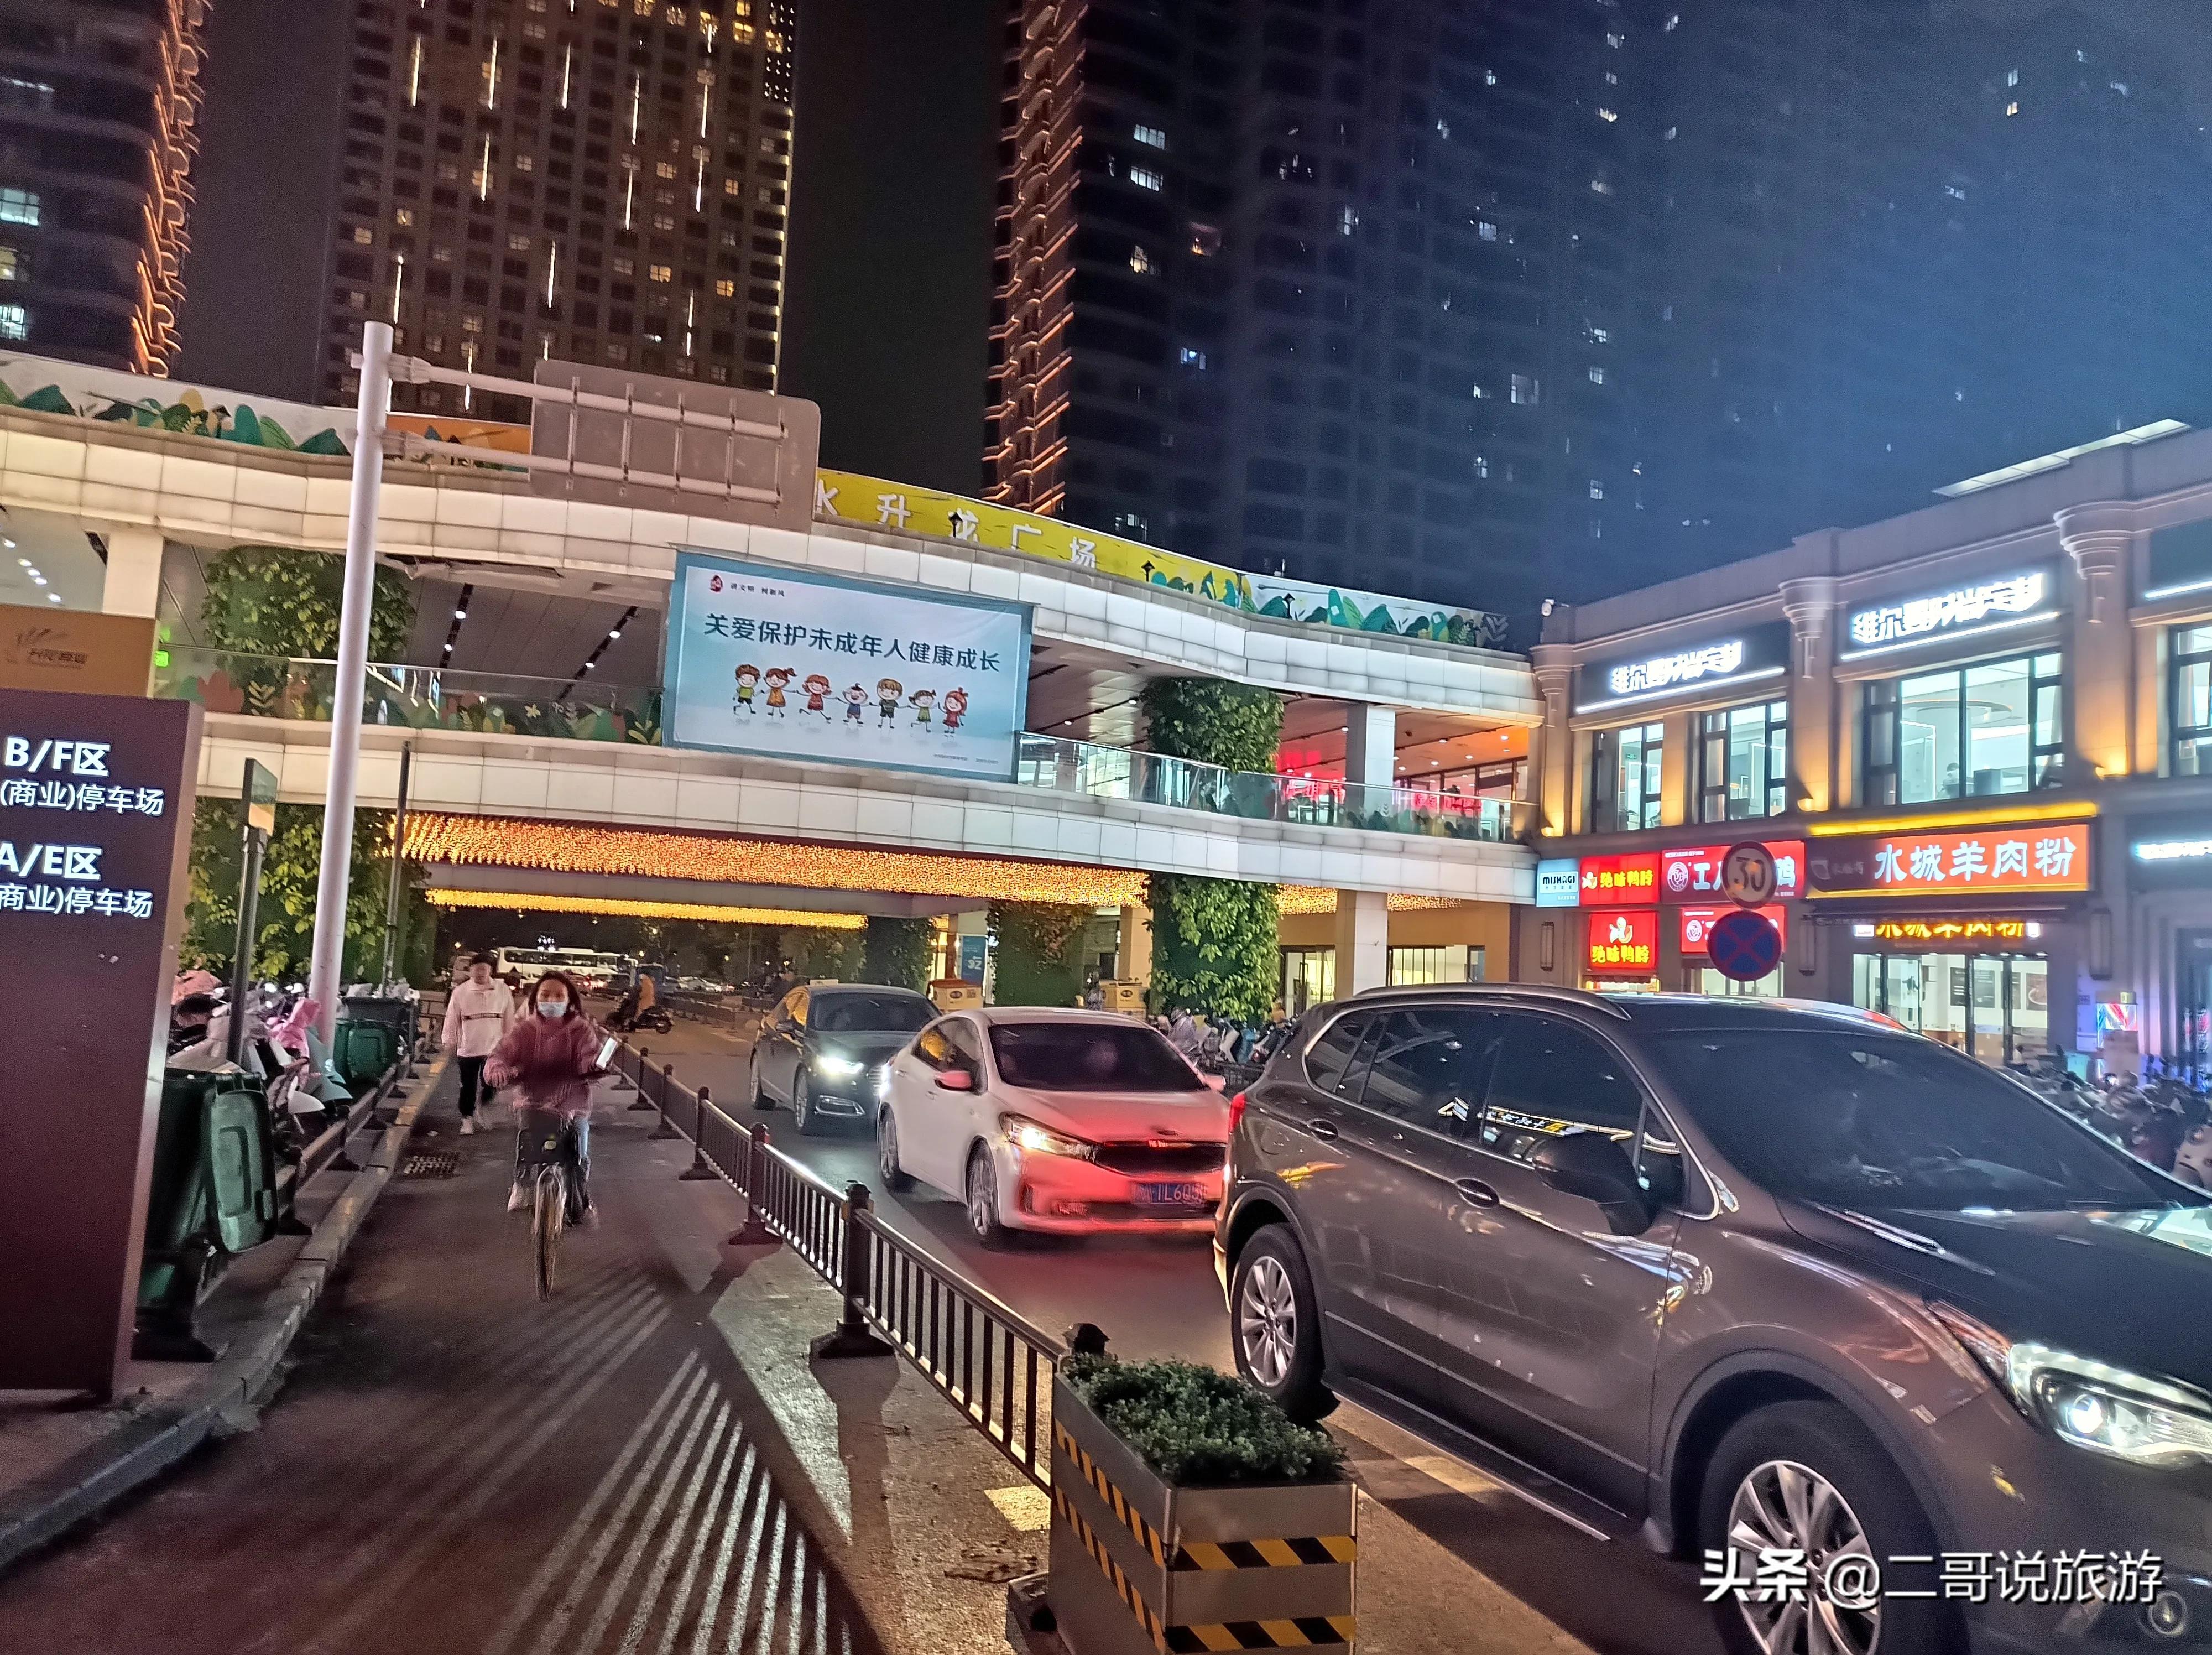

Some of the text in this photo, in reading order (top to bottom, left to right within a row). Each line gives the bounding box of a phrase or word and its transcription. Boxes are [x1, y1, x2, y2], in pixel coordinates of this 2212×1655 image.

[704, 613, 1000, 673] 关爱保护未成年人健康成长
[4, 737, 111, 777] B/F区
[0, 779, 164, 815] (商业)停车场
[0, 841, 102, 880] A/E区
[1874, 836, 2077, 883] 水城羊肉粉
[1600, 869, 1653, 888] 绝味鸭脖
[0, 883, 153, 918] 商业)停车场
[1591, 944, 1650, 964] 绝味鸭脖
